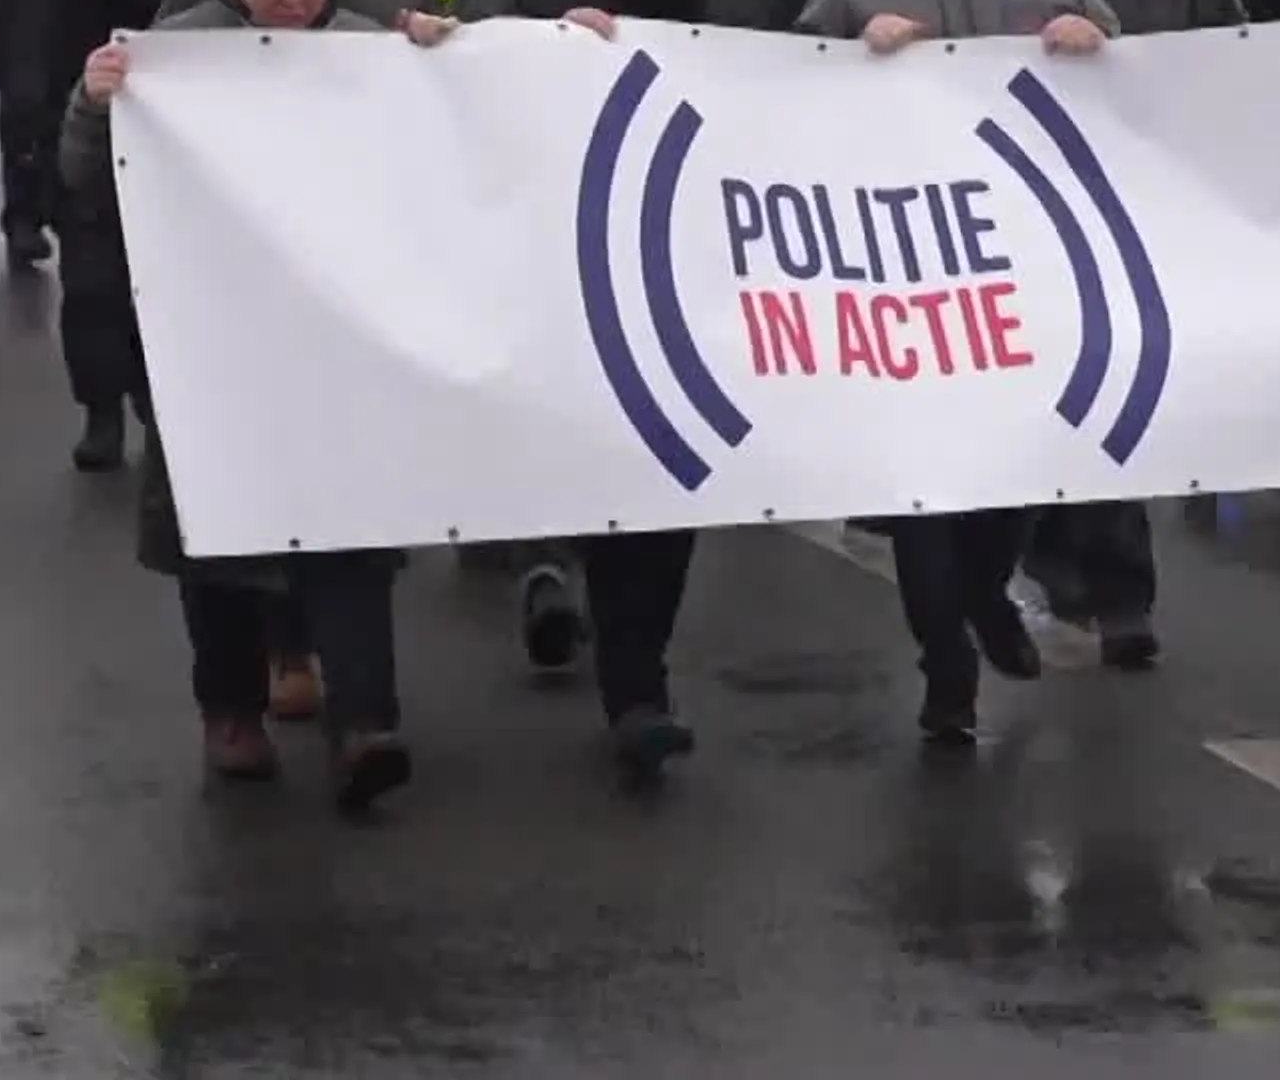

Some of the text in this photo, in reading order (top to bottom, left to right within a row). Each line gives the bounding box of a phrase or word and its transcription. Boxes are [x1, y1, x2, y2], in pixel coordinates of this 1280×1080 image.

[722, 179, 1012, 282] POLITIE
[740, 283, 1034, 380] IN ACTIE
